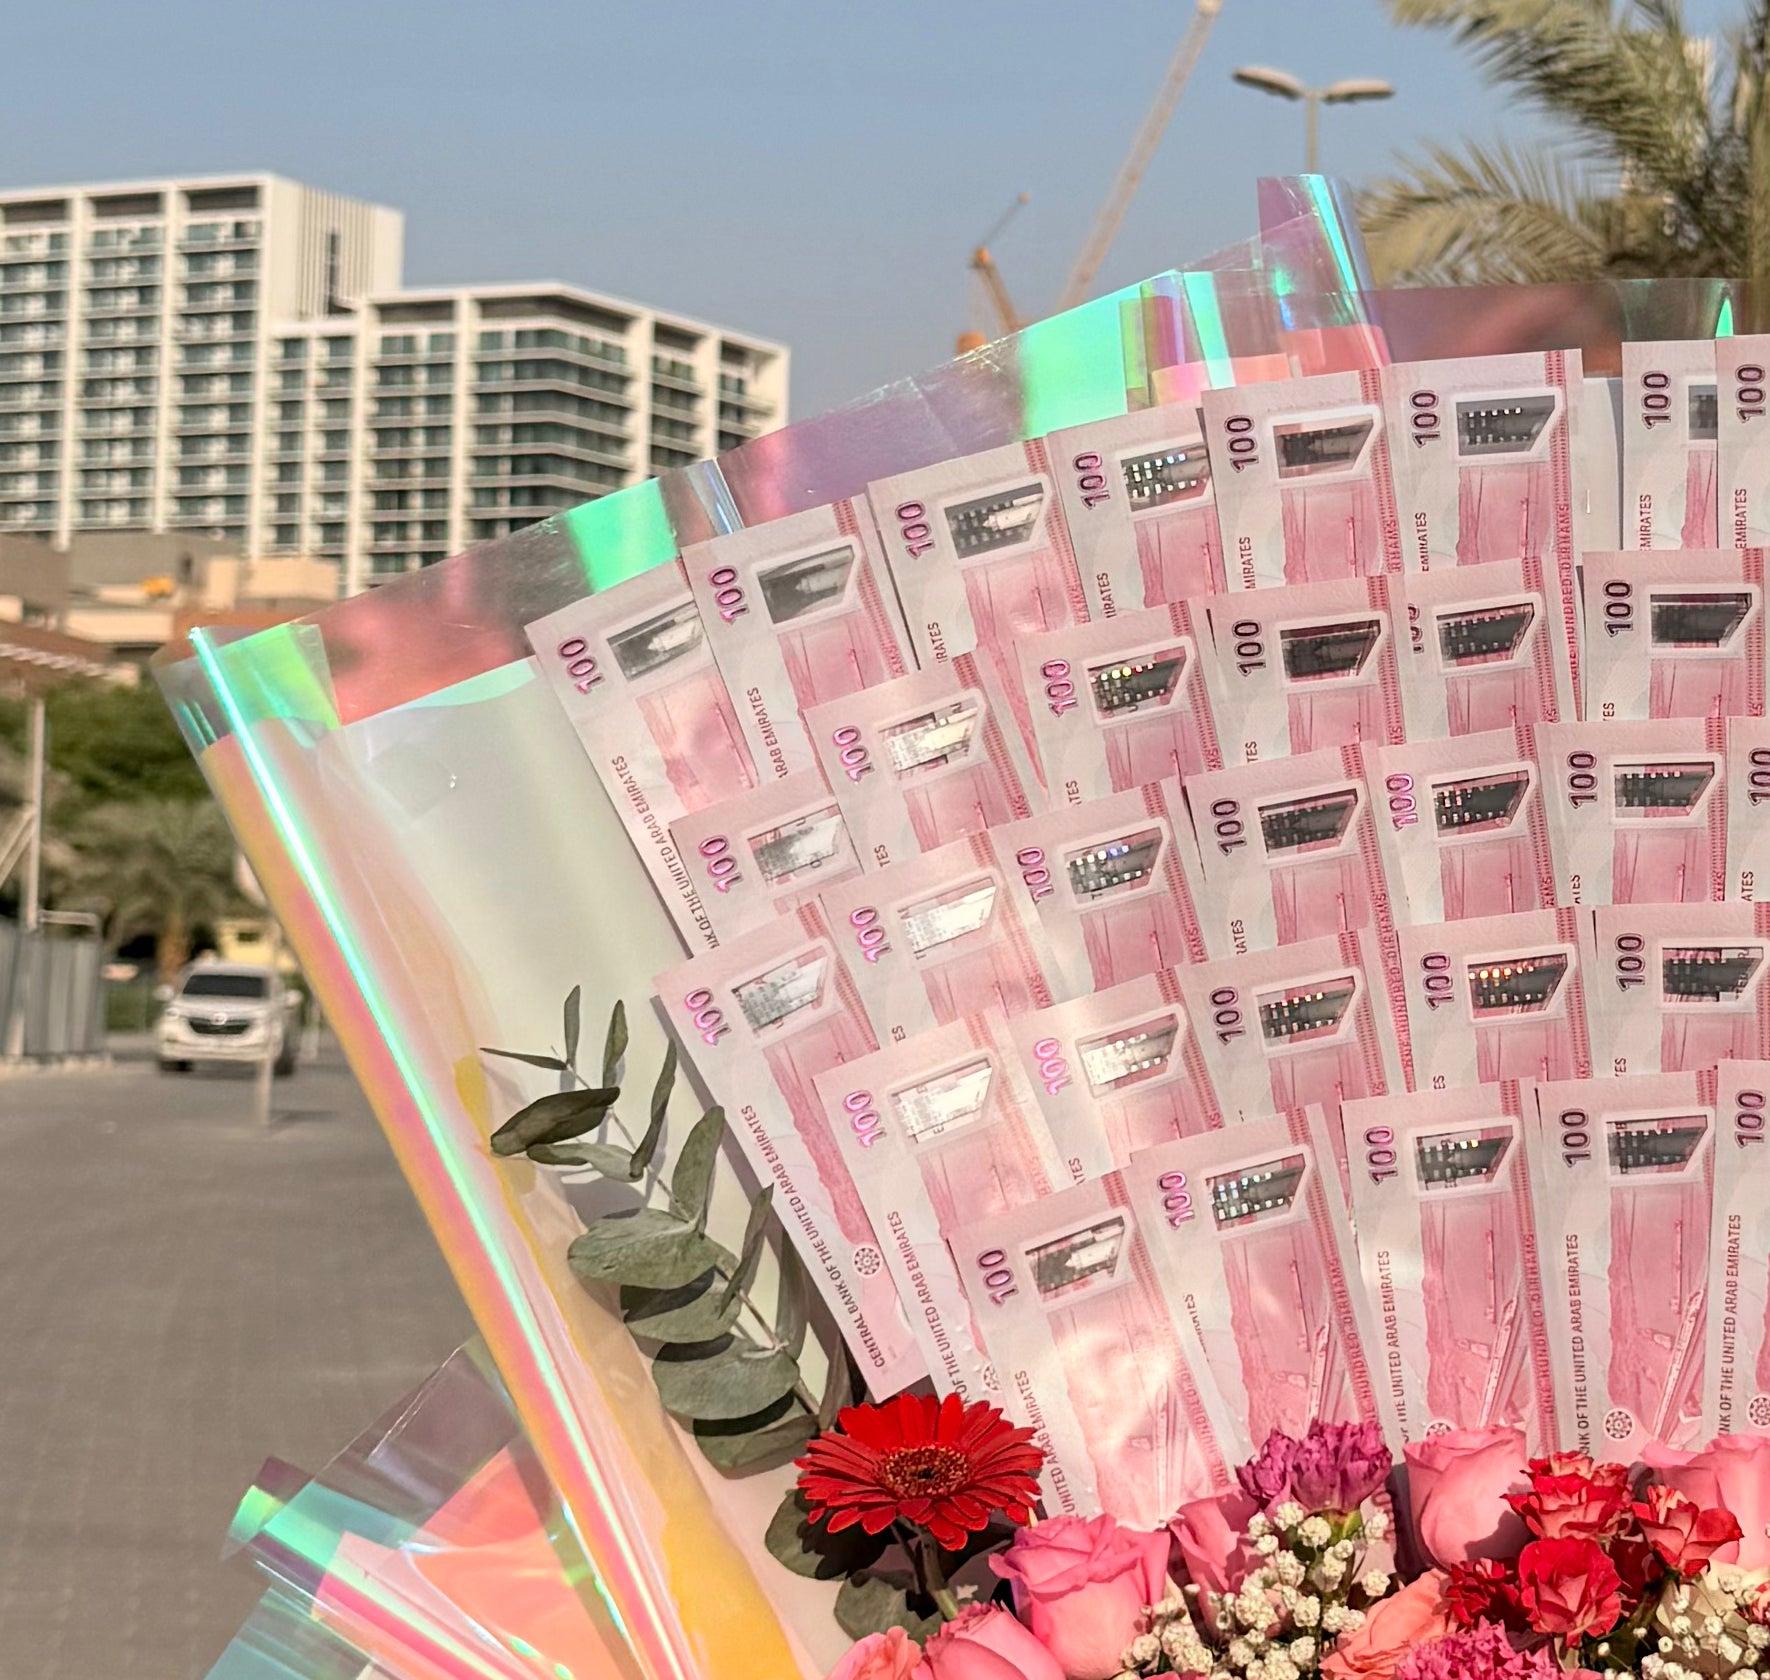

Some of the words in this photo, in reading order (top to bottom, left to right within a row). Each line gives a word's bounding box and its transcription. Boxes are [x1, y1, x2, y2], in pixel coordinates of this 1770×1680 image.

[1410, 390, 1441, 448] 100
[1641, 371, 1671, 430] 100
[1735, 364, 1766, 423] 100
[1224, 415, 1260, 473] 100
[1073, 451, 1111, 509] 100
[895, 501, 936, 559] 100
[1385, 519, 1402, 570] RHAMS
[1639, 494, 1651, 550] MIRATES
[1734, 488, 1747, 548] EMIRATES
[1238, 536, 1256, 589] MIRATES
[711, 567, 750, 625] 100
[1095, 571, 1116, 618] IRATES
[1604, 580, 1634, 638] 100
[559, 638, 603, 695] 100
[926, 620, 948, 663] IRATES
[1233, 620, 1266, 676] 100
[746, 686, 778, 747] EMIRATES
[1040, 658, 1078, 717] 100
[832, 725, 875, 784] 100
[1567, 751, 1598, 809] 100
[611, 754, 650, 814] EMIRATES
[1384, 773, 1418, 832] 100
[641, 812, 667, 847] ARAB
[1210, 798, 1248, 857] 100
[659, 845, 690, 890] UNITED
[699, 835, 744, 893] 100
[1016, 846, 1054, 905] 100
[1741, 871, 1753, 901] ATES
[682, 888, 703, 914] THE
[694, 913, 711, 932] OF
[850, 906, 894, 965] 100
[1615, 933, 1645, 993] 100
[1420, 952, 1455, 1011] 100
[684, 986, 731, 1046] 100
[1211, 987, 1245, 1046] 100
[1033, 1037, 1074, 1097] 100
[739, 1103, 779, 1164] EMIRATES
[843, 1089, 887, 1148] 100
[1560, 1107, 1592, 1167] 100
[1735, 1089, 1766, 1149] 100
[770, 1161, 797, 1197] ARAB
[1364, 1125, 1398, 1185] 100
[788, 1194, 820, 1240] UNITED
[1158, 1171, 1195, 1230] 100
[811, 1237, 833, 1264] THE
[886, 1209, 920, 1271] EMIRATES
[1565, 1234, 1581, 1296] EMIRATES
[1725, 1214, 1740, 1276] EMIRATES
[824, 1262, 842, 1281] OF
[833, 1279, 859, 1314] BANK
[910, 1270, 933, 1305] ARAB
[976, 1248, 1019, 1306] 100
[1376, 1250, 1395, 1312] EMIRATES
[1724, 1280, 1737, 1313] ARAB
[850, 1312, 887, 1368] CENTRAL
[923, 1305, 951, 1351] UNITED
[1384, 1314, 1399, 1348] ARAB
[1569, 1299, 1583, 1332] ARAB
[1721, 1317, 1735, 1363] UNITED
[941, 1351, 961, 1376] THE
[951, 1376, 967, 1394] OF
[1388, 1351, 1405, 1396] UNITED
[1572, 1335, 1586, 1382] UNITED
[1720, 1366, 1733, 1391] THE
[1014, 1369, 1046, 1431] EMIRATES
[1575, 1385, 1588, 1409] THE
[1577, 1412, 1589, 1428] OF
[1719, 1393, 1731, 1410] OF
[1049, 1466, 1076, 1513] UNITED
